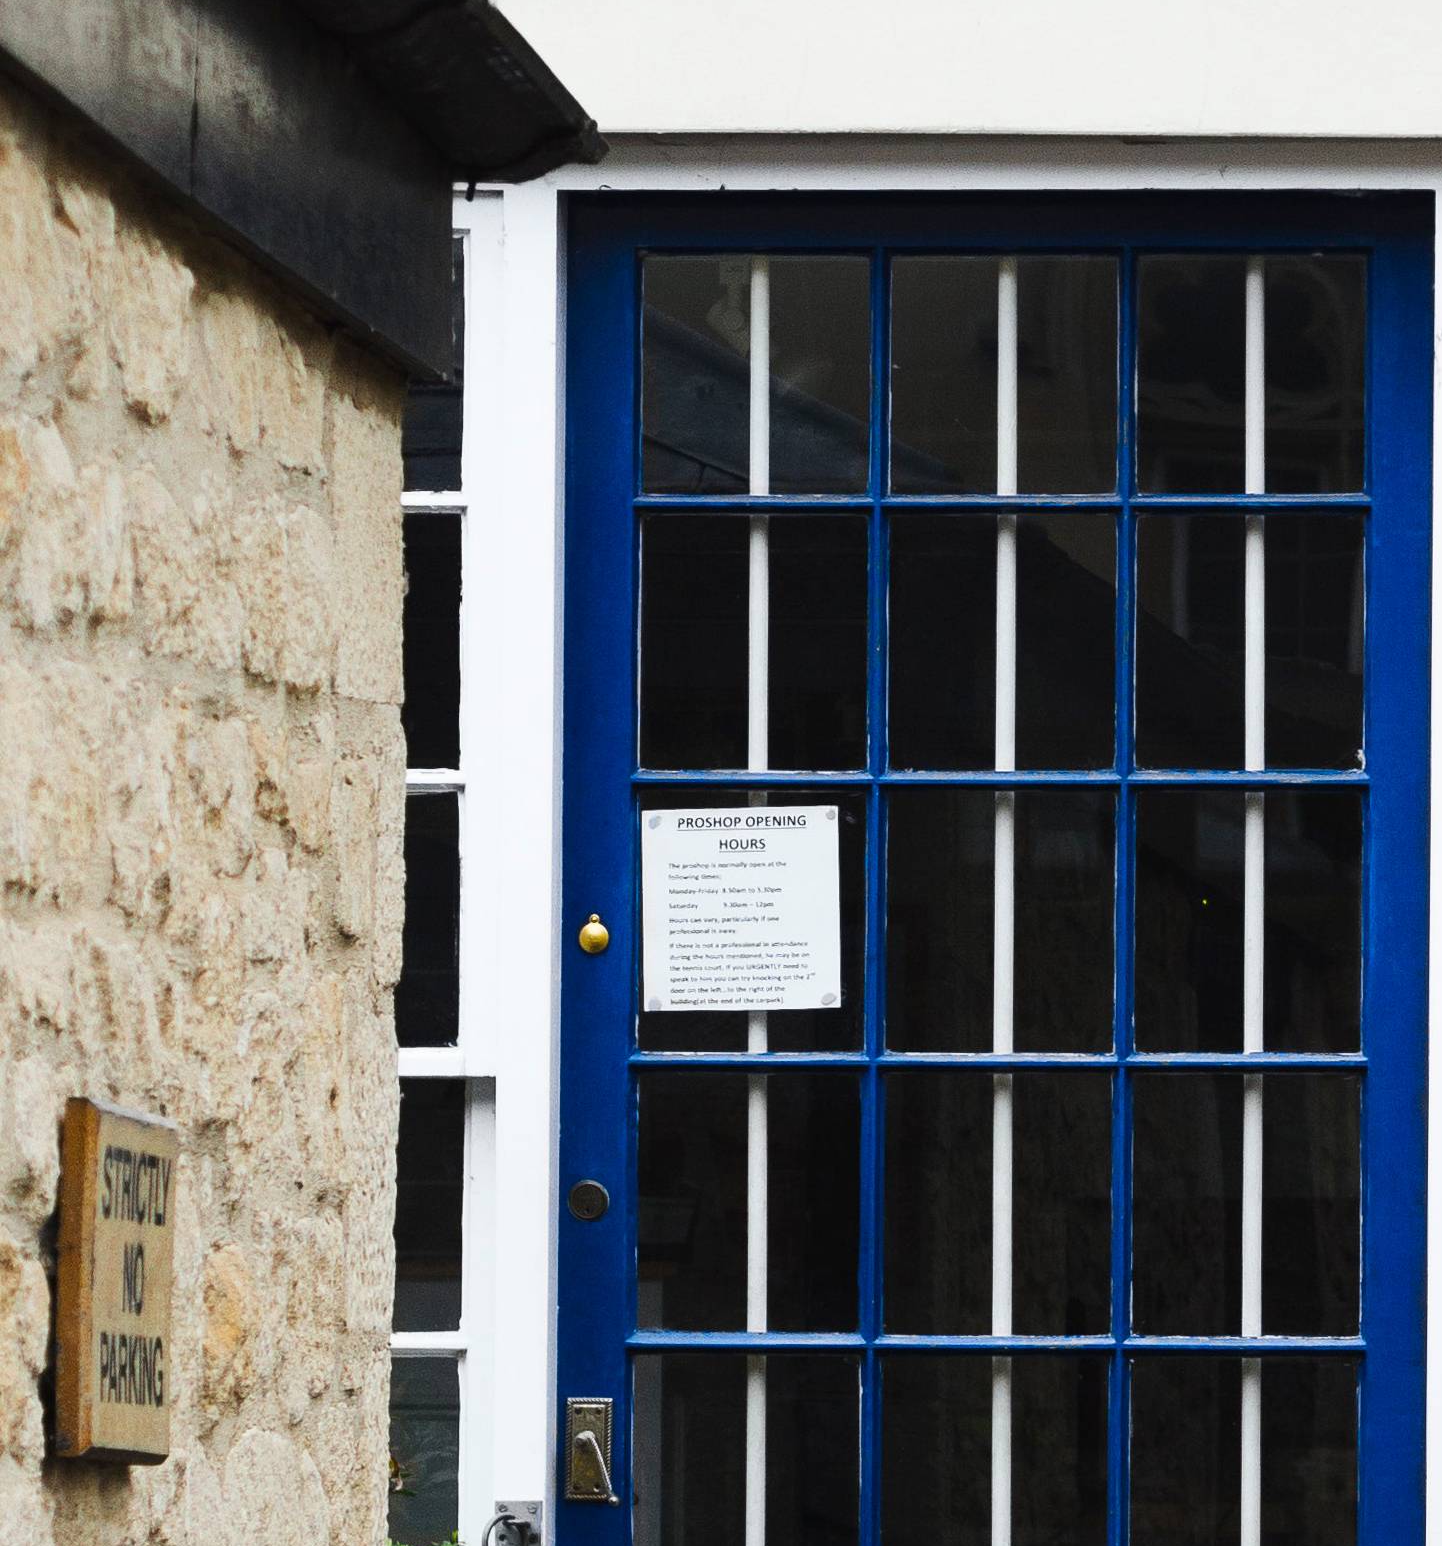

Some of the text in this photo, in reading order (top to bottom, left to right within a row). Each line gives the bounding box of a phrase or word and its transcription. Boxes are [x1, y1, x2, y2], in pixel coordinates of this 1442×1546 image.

[677, 815, 807, 828] PROSHOP OPENING
[719, 838, 766, 850] HOURS
[756, 901, 774, 909] 12pm
[746, 963, 781, 971] URGENTLY
[101, 1144, 172, 1227] STRICTLY
[121, 1242, 146, 1316] NO
[99, 1331, 165, 1407] PARKING
